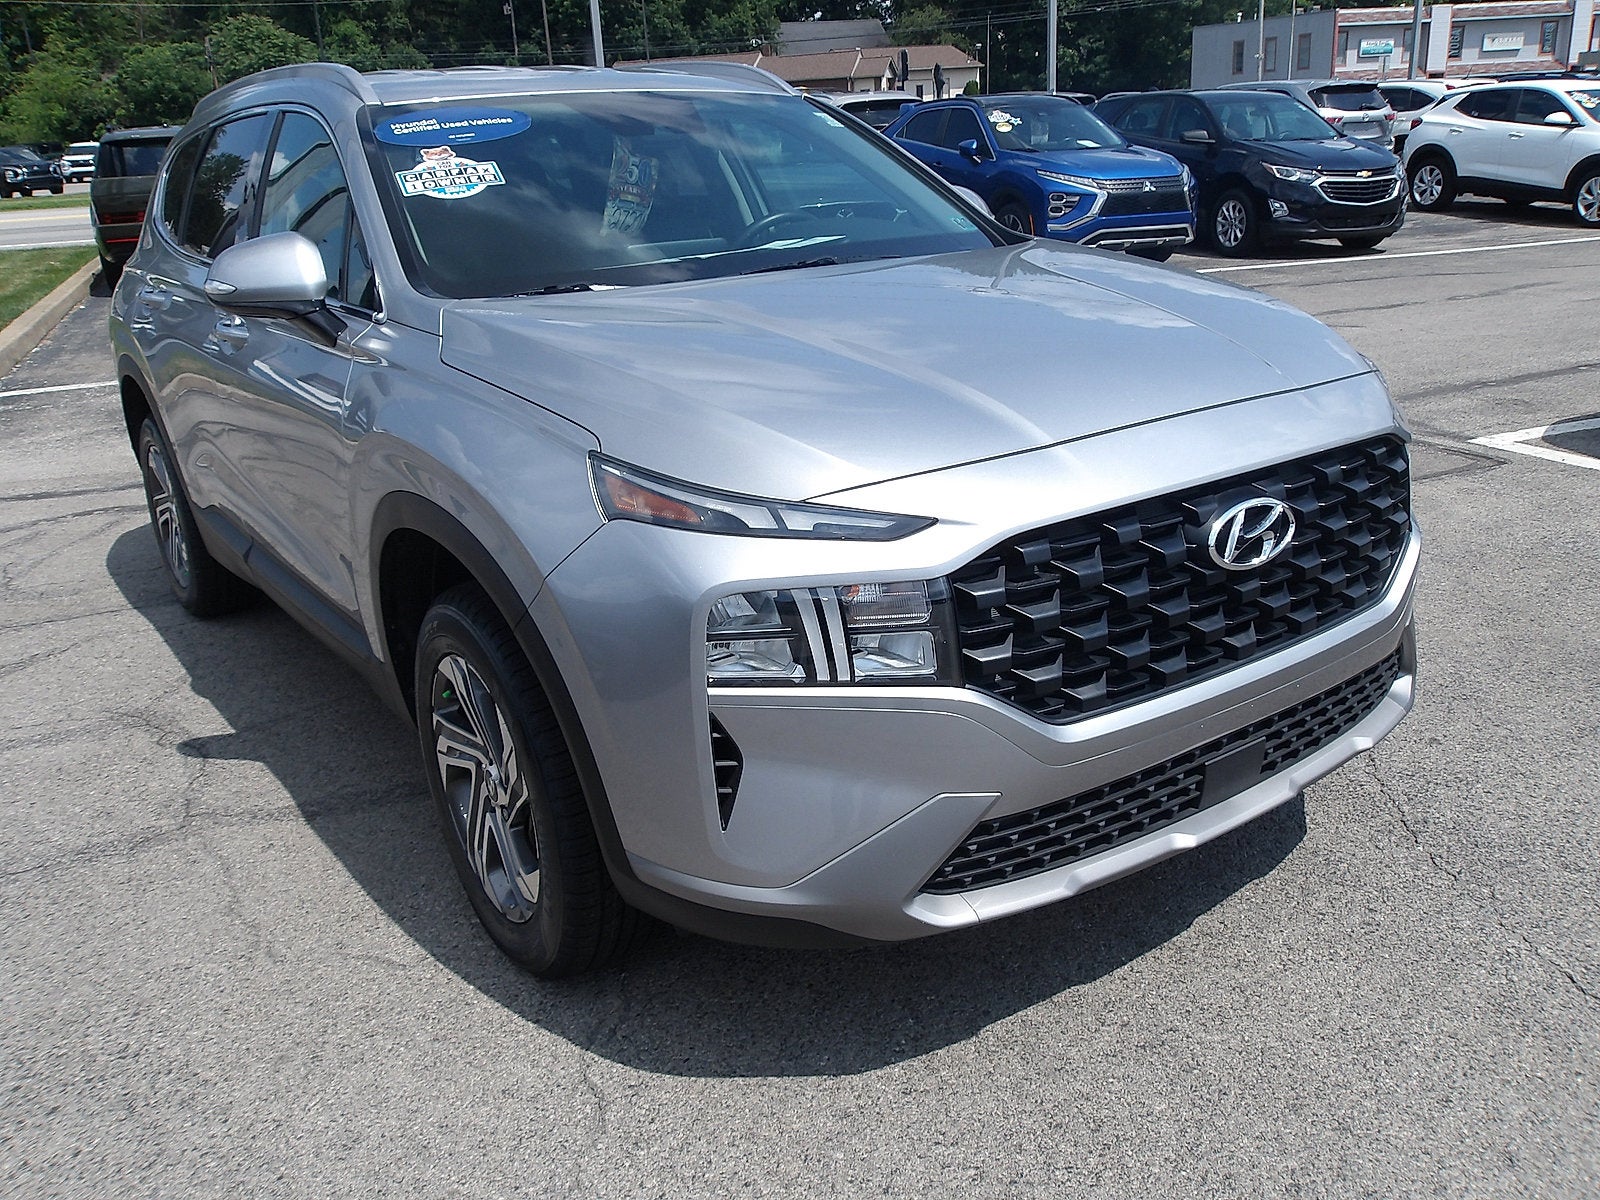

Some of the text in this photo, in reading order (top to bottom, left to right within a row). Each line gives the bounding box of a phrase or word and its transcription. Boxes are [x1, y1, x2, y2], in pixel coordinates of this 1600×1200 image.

[1449, 28, 1460, 57] YOGA
[391, 118, 437, 130] Hyundai
[393, 117, 513, 135] Certified Used Vehicles
[403, 167, 490, 182] CARFAX
[422, 174, 498, 189] OWNER
